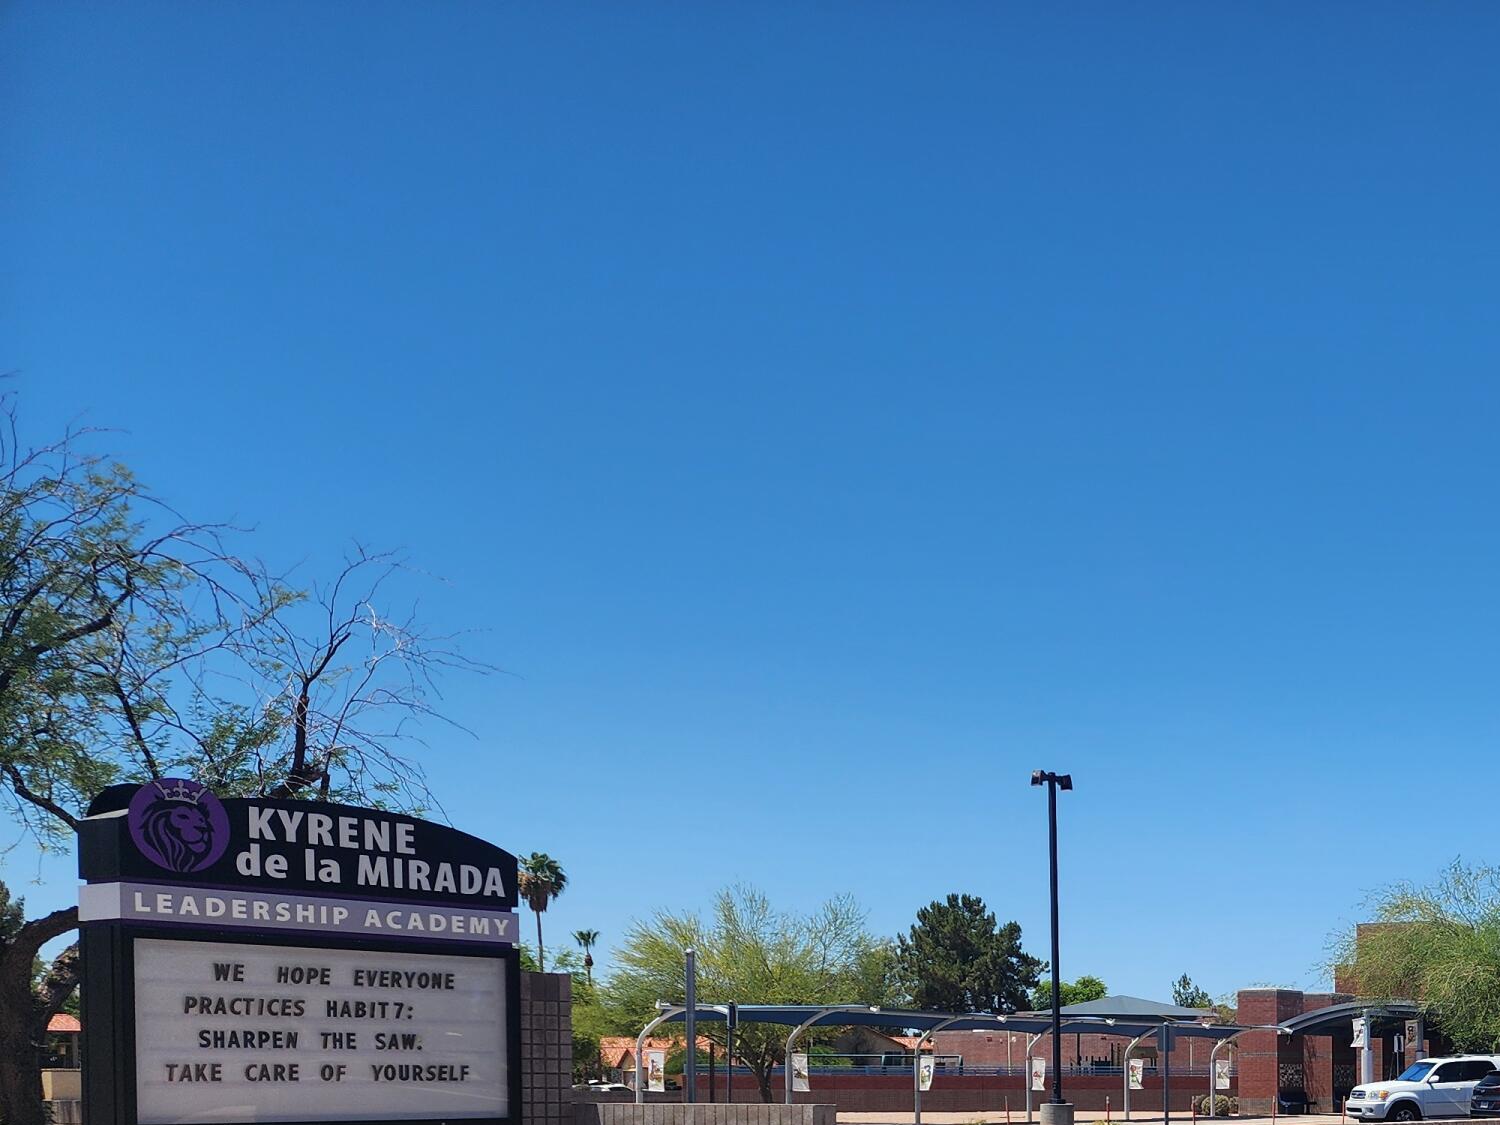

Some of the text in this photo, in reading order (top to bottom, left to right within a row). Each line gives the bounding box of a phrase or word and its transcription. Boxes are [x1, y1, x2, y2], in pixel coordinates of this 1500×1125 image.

[248, 805, 416, 855] KYRENE
[235, 843, 506, 898] de la MIRADA
[134, 892, 509, 936] LEADERSHIP ACADEMY
[213, 963, 455, 990] WE HOPE EVERYONE
[183, 996, 305, 1017] PRACTICES
[199, 1030, 298, 1049] SHARPEN
[320, 1031, 356, 1049] THE
[165, 1063, 470, 1082] TAKE CARE OF YOURSELF
